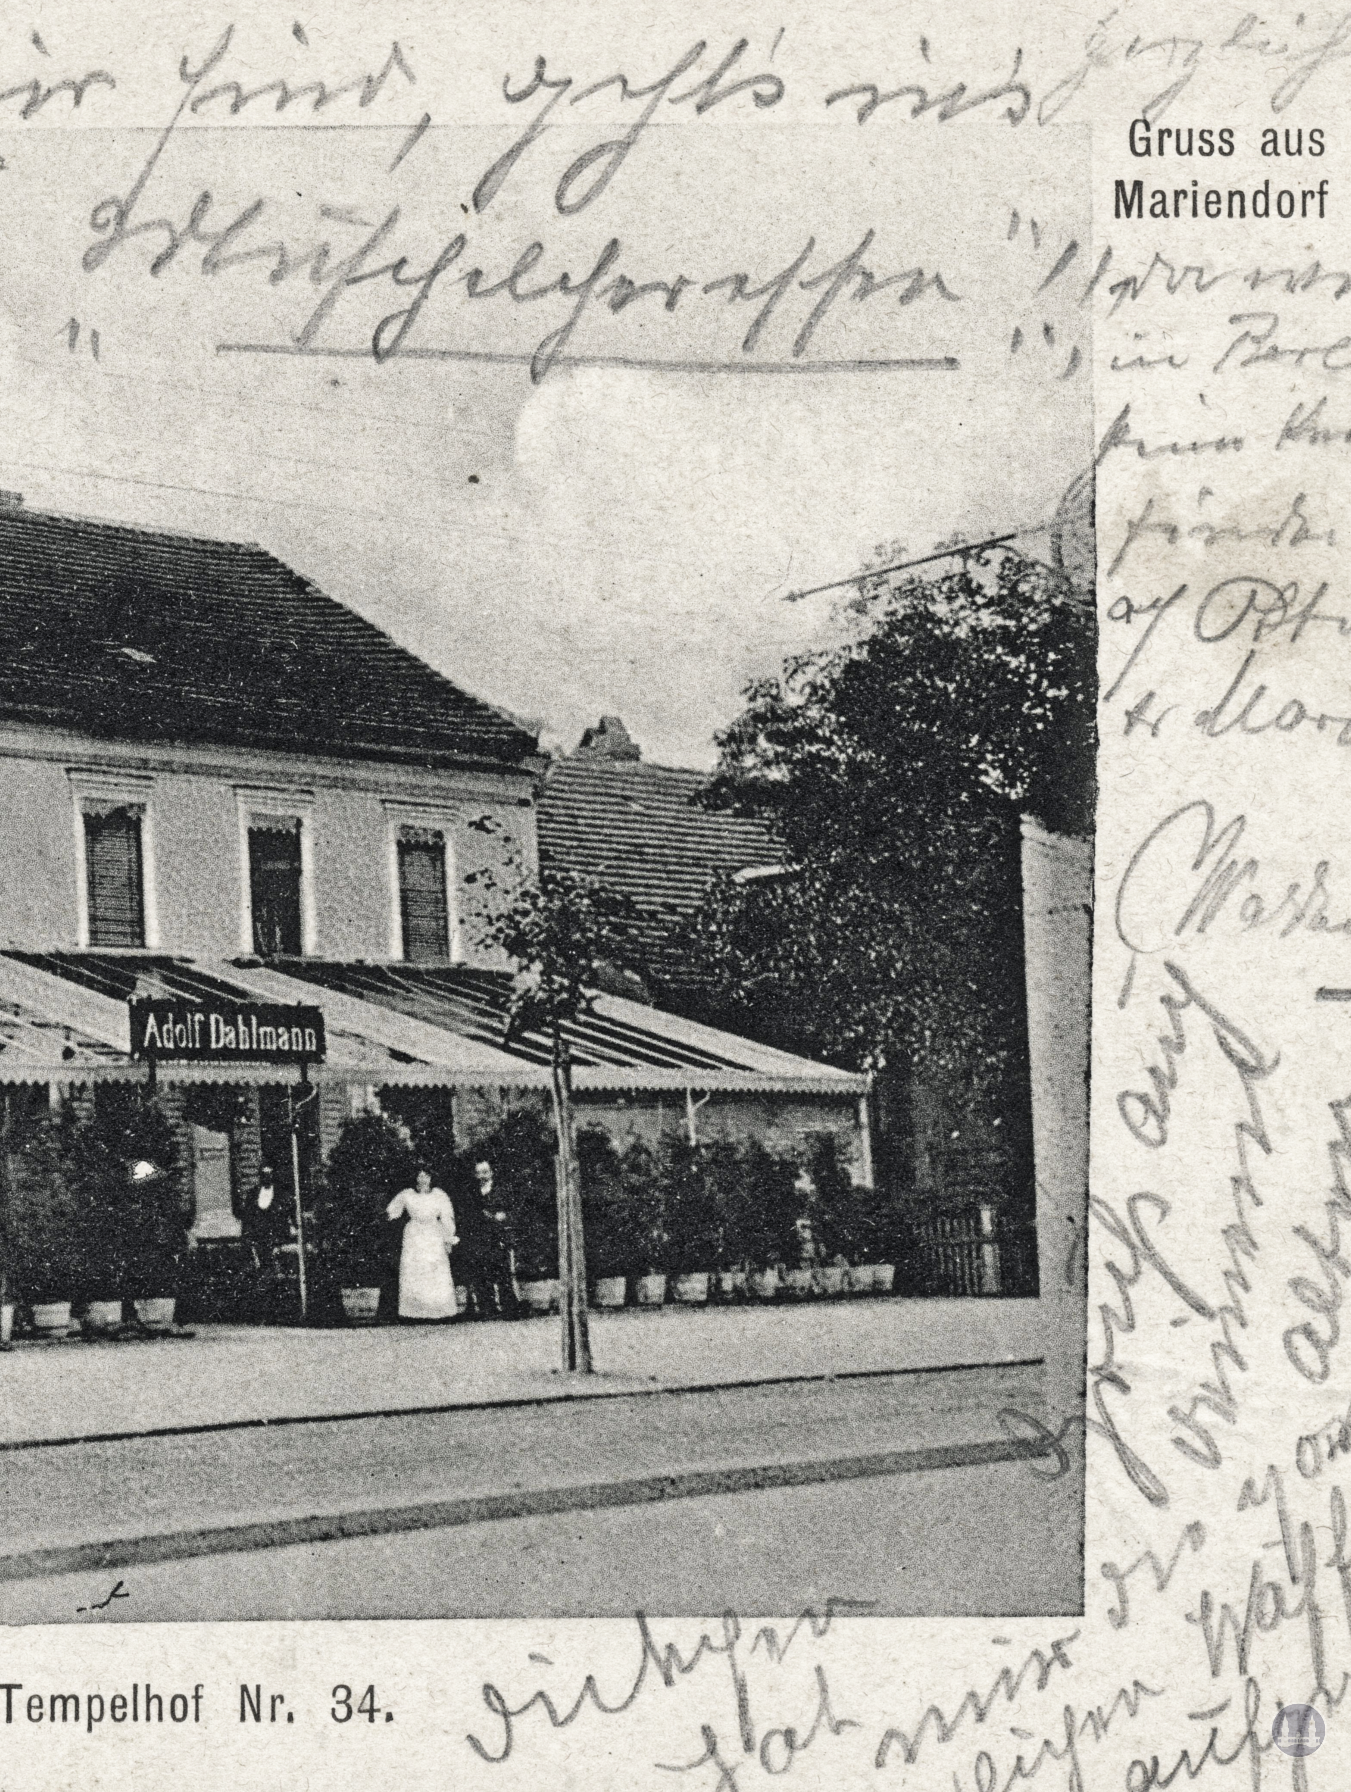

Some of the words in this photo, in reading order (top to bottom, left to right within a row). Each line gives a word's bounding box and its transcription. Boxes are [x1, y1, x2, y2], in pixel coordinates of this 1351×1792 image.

[1129, 118, 1236, 158] Gruss
[1260, 128, 1326, 158] aus
[1114, 179, 1330, 219] Mariendorf
[143, 1012, 205, 1049] Adolf
[209, 1013, 317, 1051] Dahlmann
[241, 1685, 296, 1725] Nr.
[332, 1685, 396, 1725] 34.
